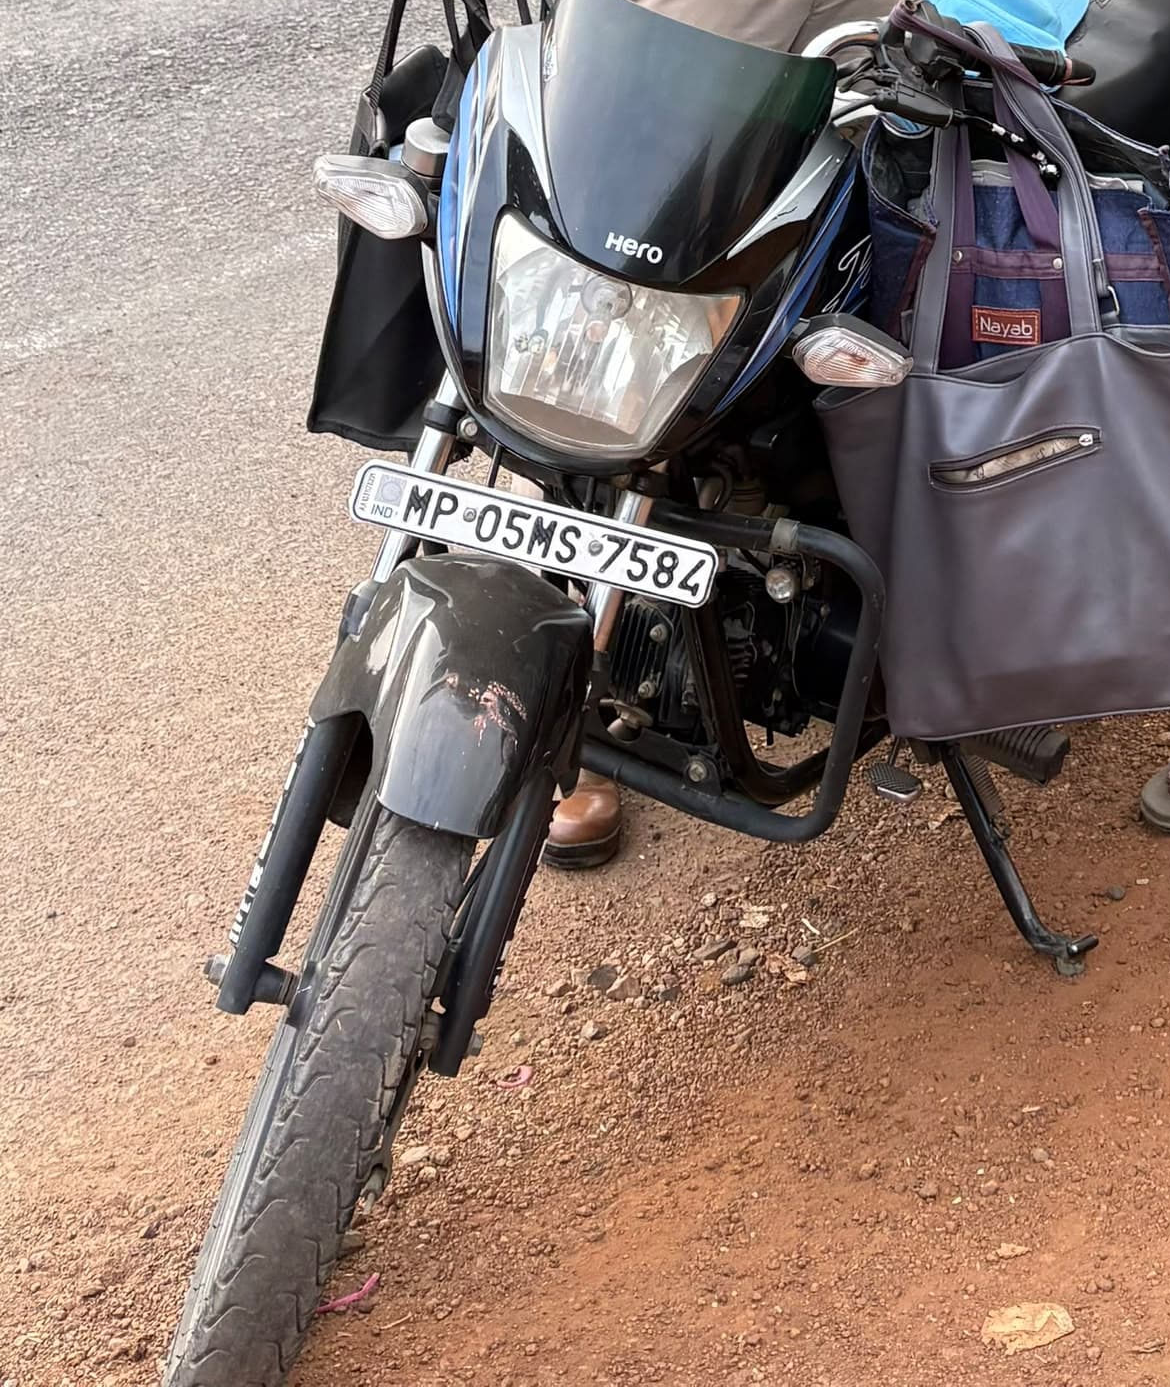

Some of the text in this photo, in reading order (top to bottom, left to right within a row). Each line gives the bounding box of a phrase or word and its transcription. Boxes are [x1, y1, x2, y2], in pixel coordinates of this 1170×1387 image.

[605, 232, 663, 264] Hero
[980, 315, 1033, 338] Nayab
[371, 503, 393, 519] IND
[402, 484, 459, 530] MP
[474, 503, 582, 564] 05MS
[598, 533, 706, 597] 7584
